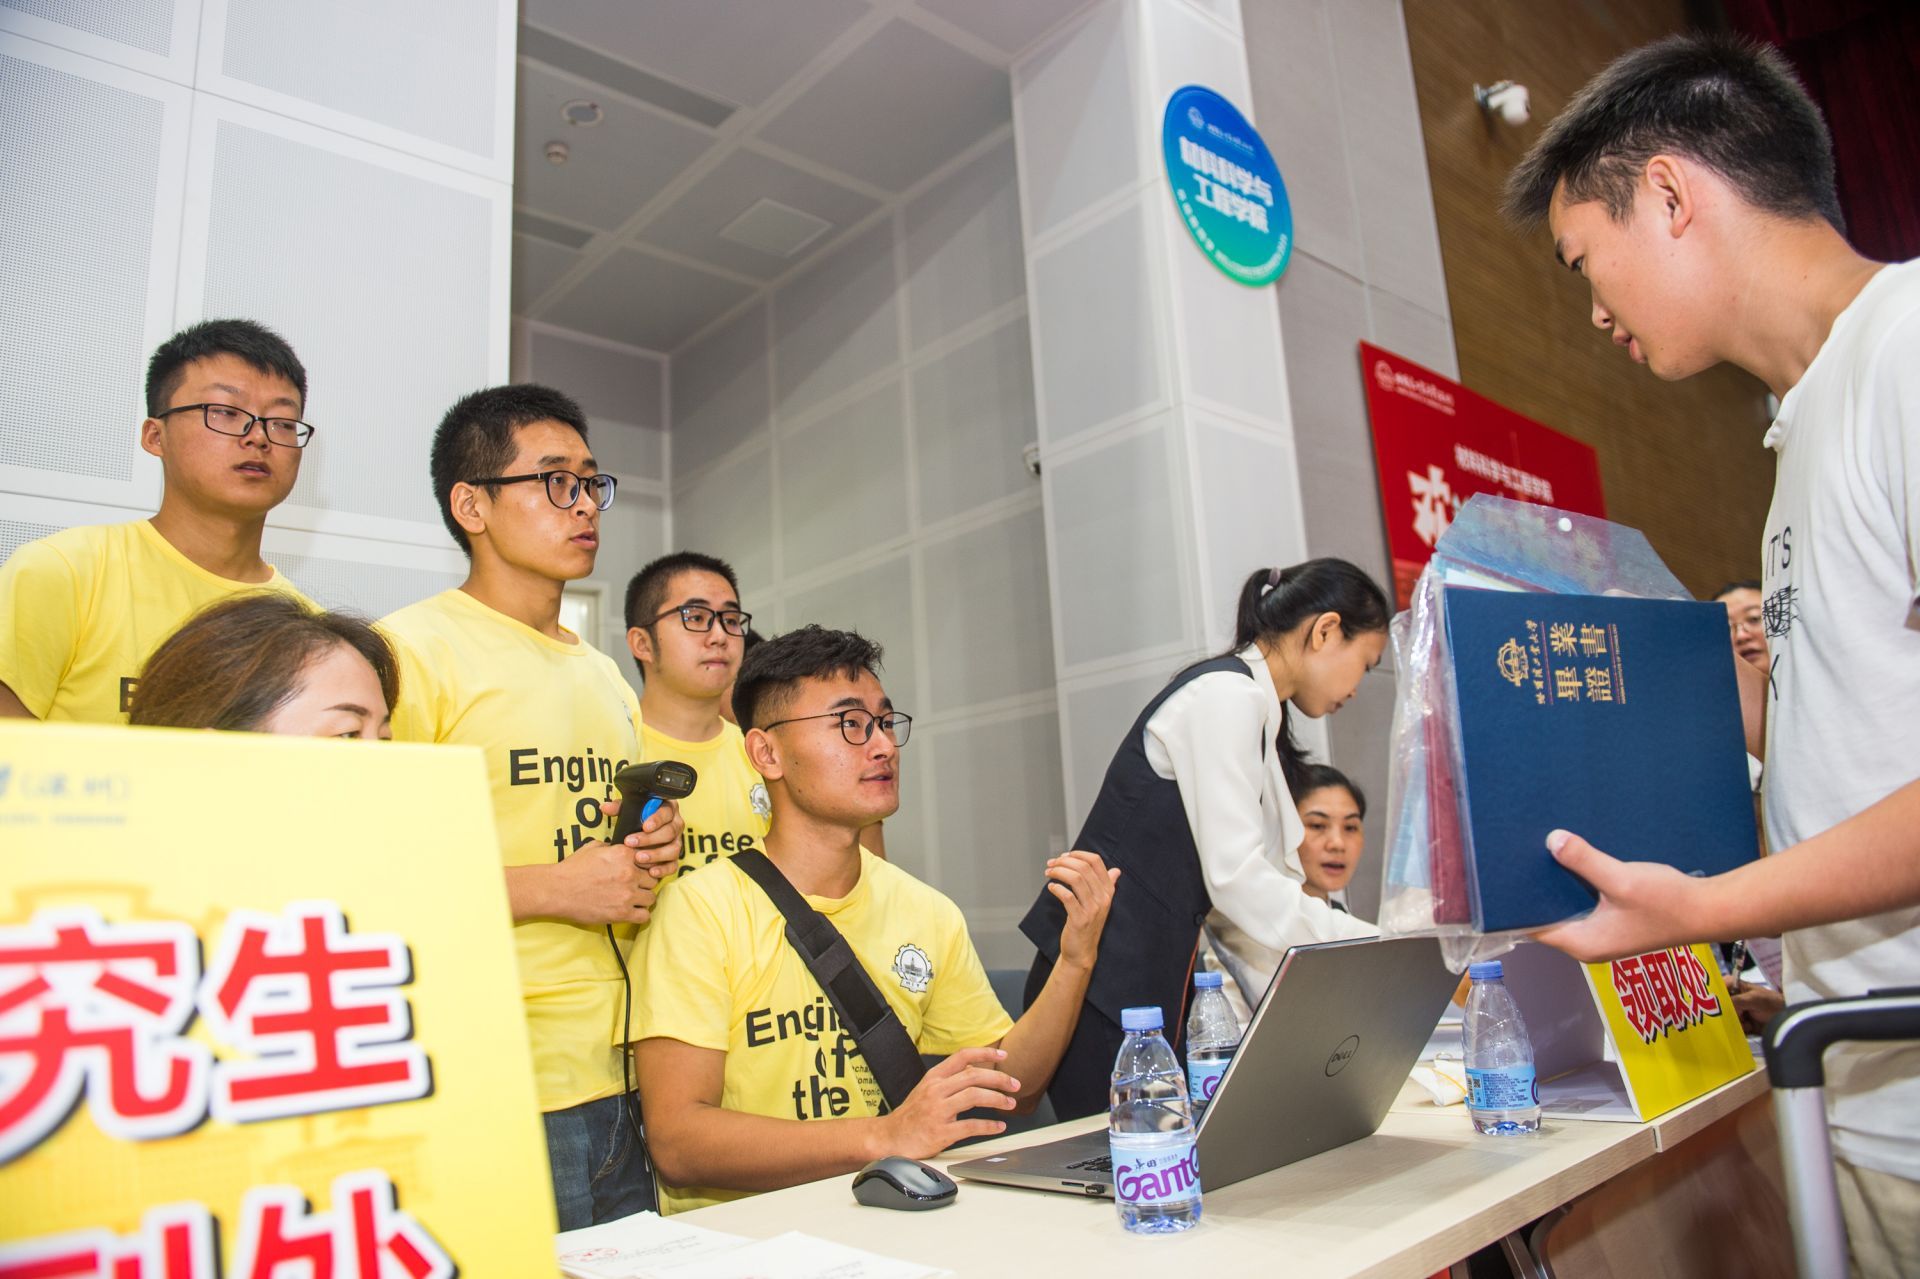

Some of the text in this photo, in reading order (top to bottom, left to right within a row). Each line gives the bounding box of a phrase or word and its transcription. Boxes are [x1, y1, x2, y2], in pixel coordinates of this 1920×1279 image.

[554, 824, 613, 863] th
[1611, 945, 1720, 1040] 领取处
[0, 908, 424, 1152] 究生
[793, 1075, 850, 1120] the
